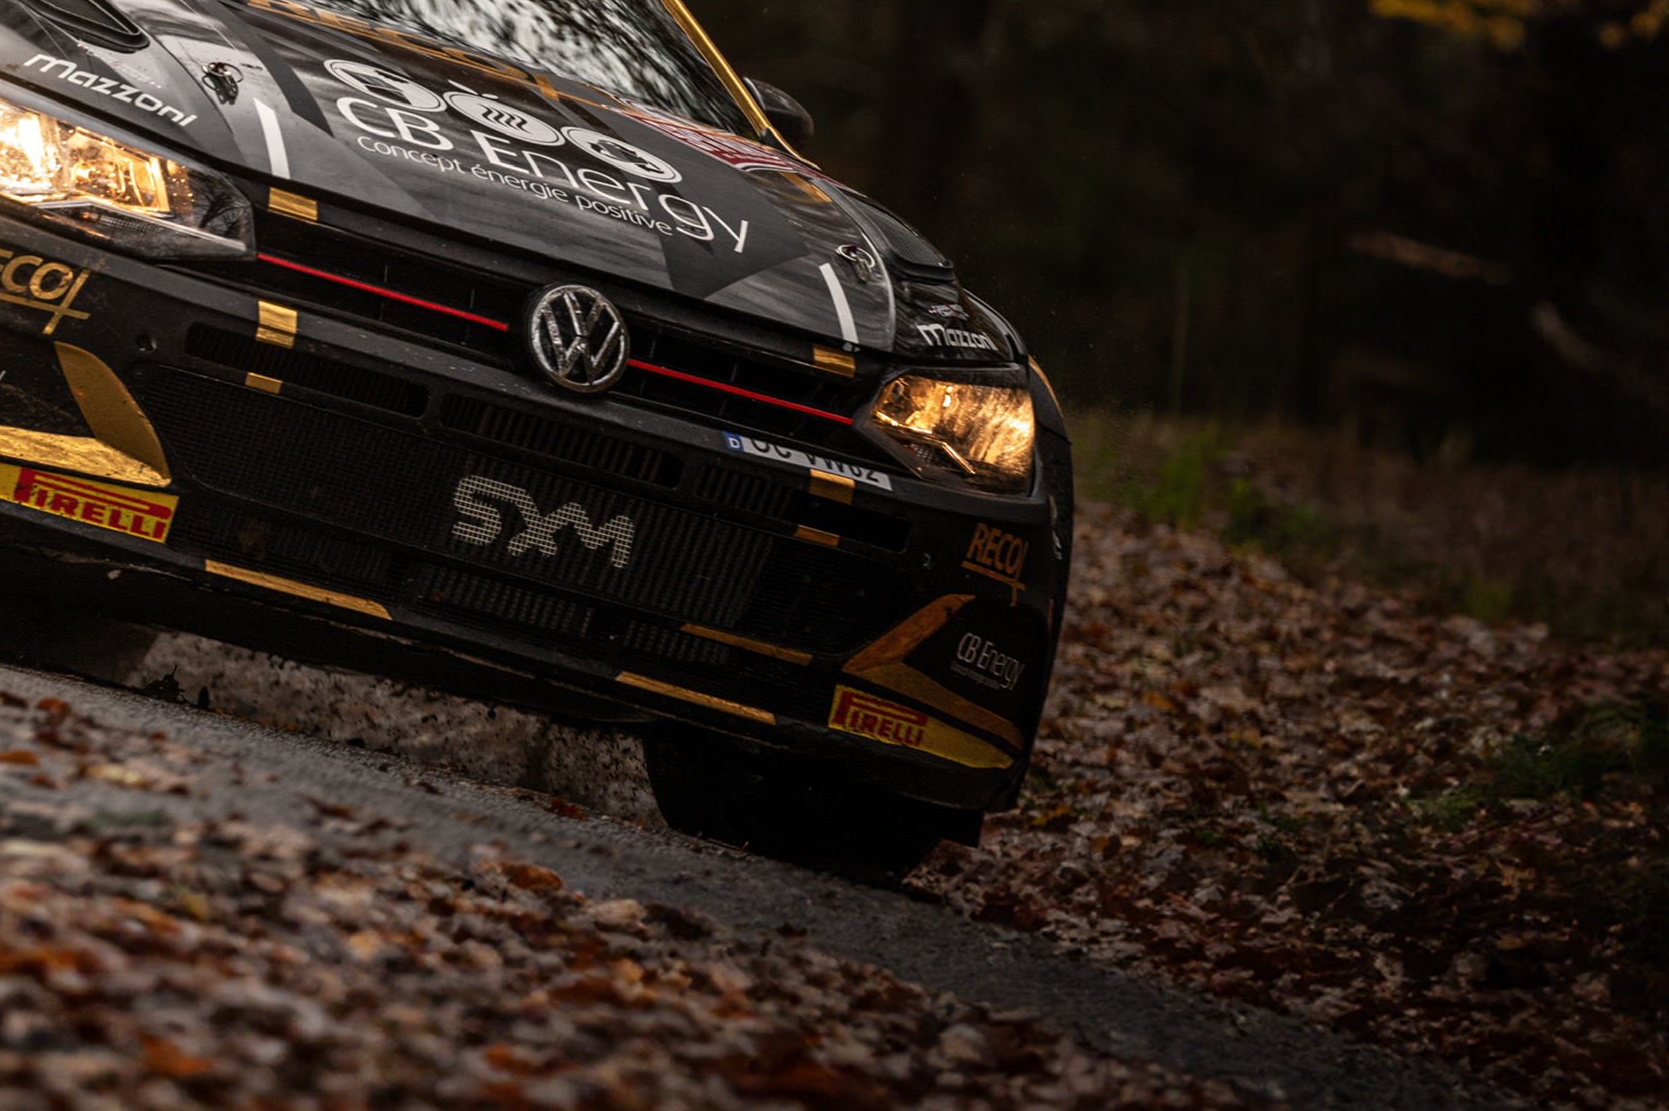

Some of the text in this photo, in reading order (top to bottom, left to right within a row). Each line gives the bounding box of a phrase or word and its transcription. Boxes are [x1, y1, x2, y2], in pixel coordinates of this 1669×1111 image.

[335, 96, 455, 151] CB
[470, 129, 749, 253] Energy
[471, 162, 569, 203] énergie
[575, 195, 674, 237] positive
[14, 467, 171, 539] PIRELLI
[451, 474, 635, 569] SXM
[956, 632, 982, 664] CB
[976, 640, 1026, 691] Energy
[833, 691, 928, 746] PIRELLI
